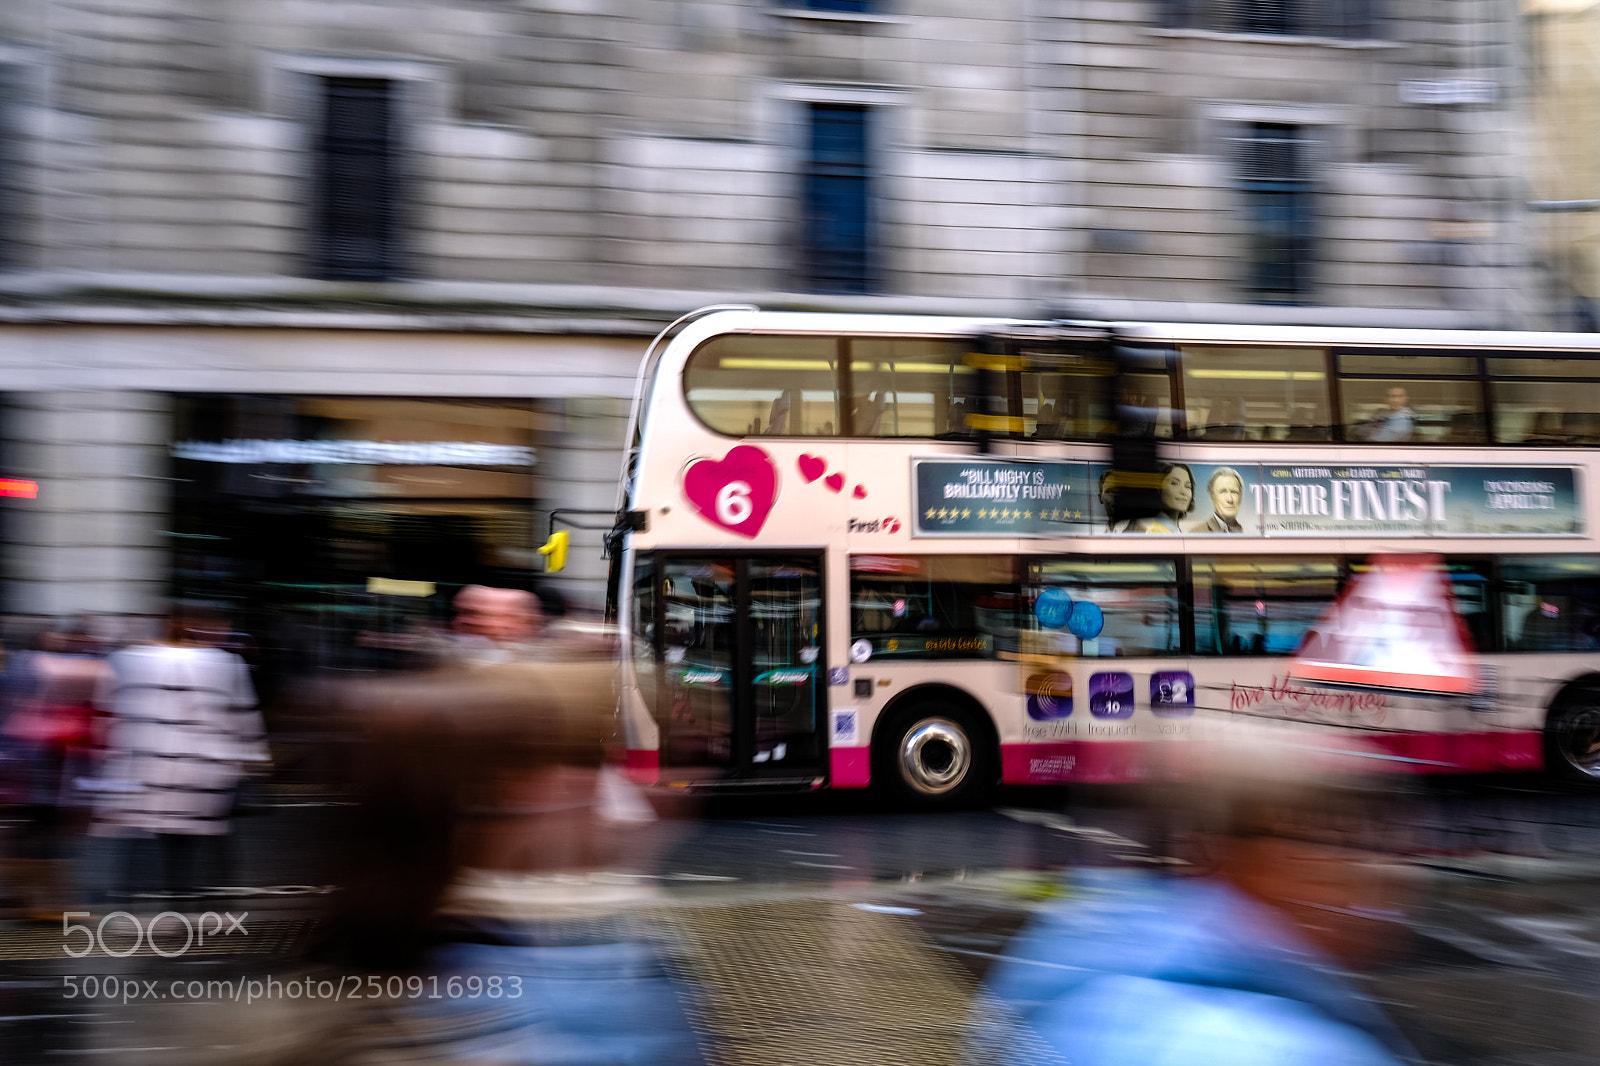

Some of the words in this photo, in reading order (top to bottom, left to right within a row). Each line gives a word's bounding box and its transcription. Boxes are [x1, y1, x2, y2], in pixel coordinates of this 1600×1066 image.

[993, 469, 1030, 484] NIGHY
[1033, 470, 1044, 485] IS
[944, 483, 1020, 499] BRILLIANTLY
[715, 480, 753, 525] 6
[1250, 484, 1329, 515] THEIR
[1330, 480, 1451, 521] FINEST
[848, 518, 880, 533] First
[1106, 700, 1120, 714] 10
[1088, 722, 1137, 737] frequent
